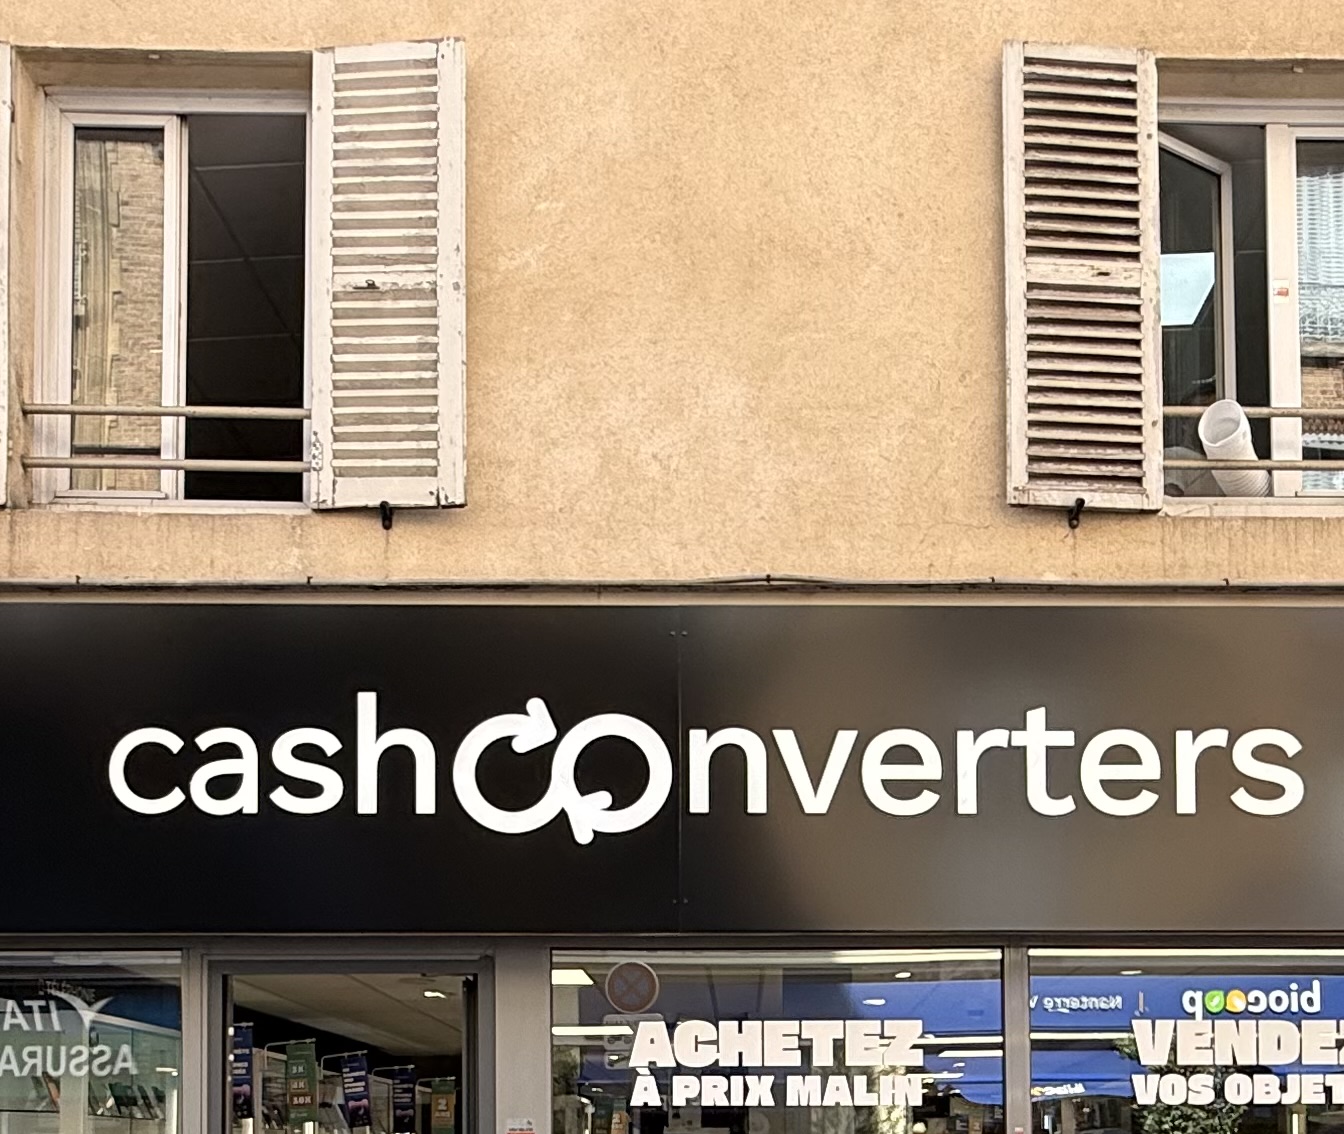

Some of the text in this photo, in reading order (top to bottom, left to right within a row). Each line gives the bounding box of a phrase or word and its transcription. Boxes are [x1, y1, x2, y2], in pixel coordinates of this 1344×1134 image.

[629, 1020, 924, 1068] ACHETEZ
[630, 1067, 923, 1107] À PRIX MALIN
[1132, 1074, 1215, 1105] VOS
